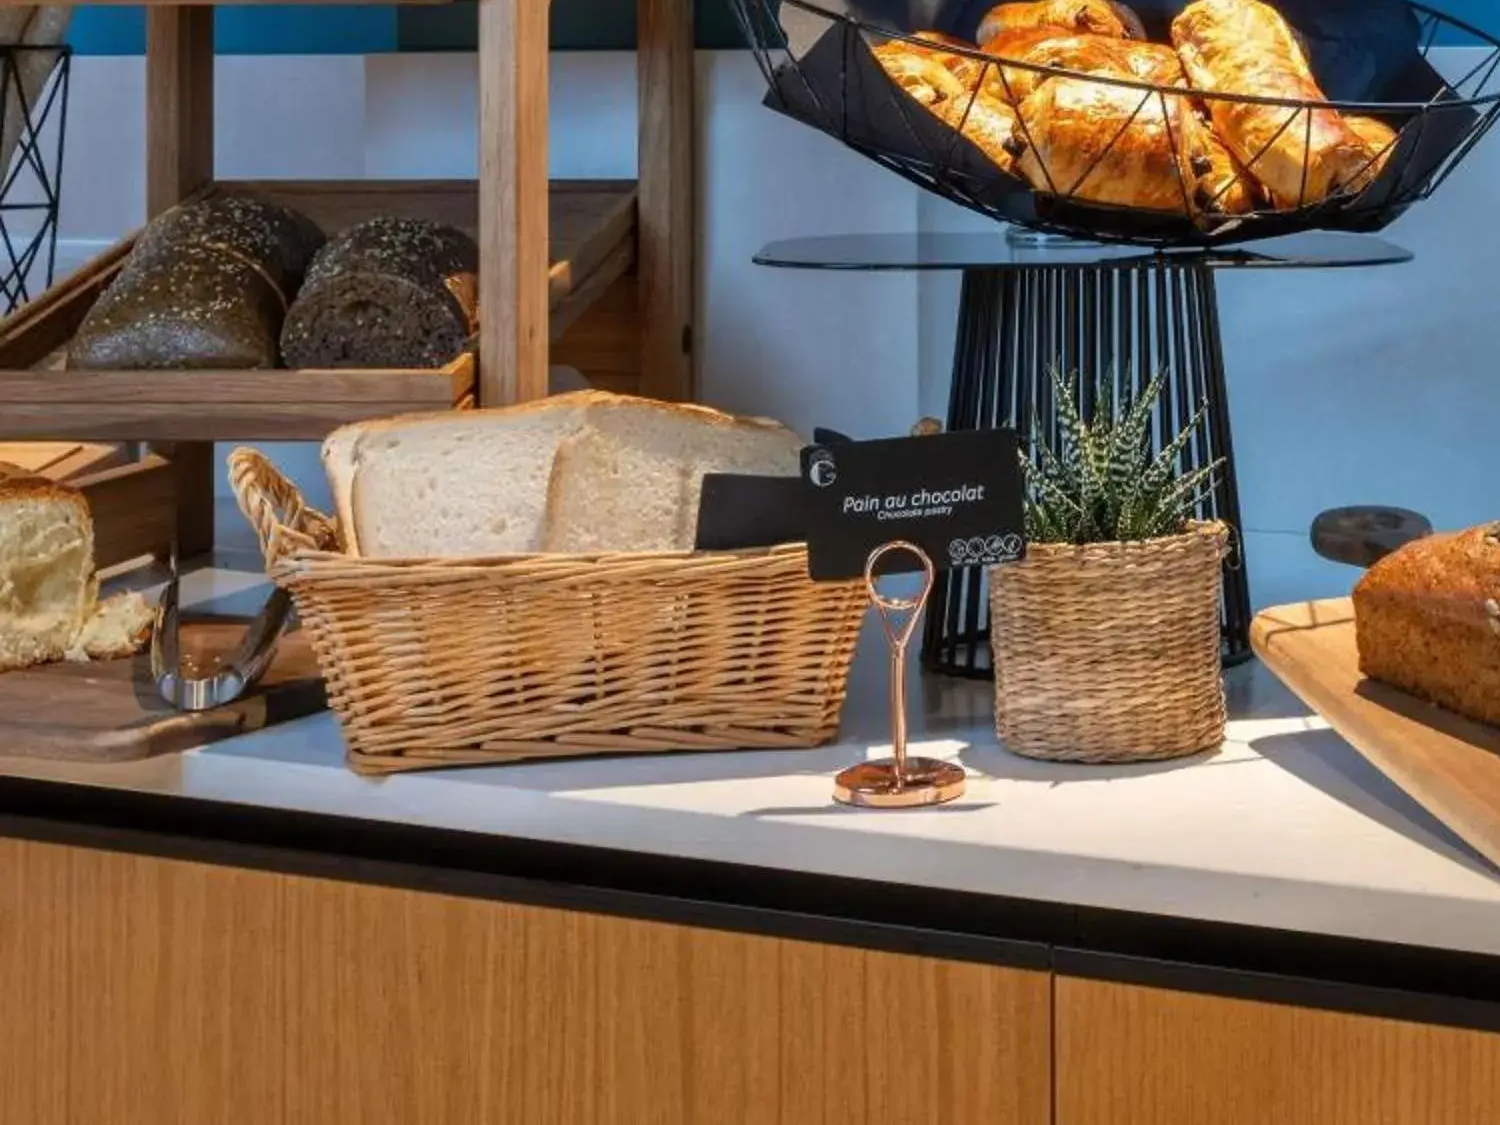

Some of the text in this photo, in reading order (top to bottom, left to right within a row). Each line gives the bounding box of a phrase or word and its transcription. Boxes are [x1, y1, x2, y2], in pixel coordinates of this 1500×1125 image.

[843, 484, 985, 514] Pain au chocolat
